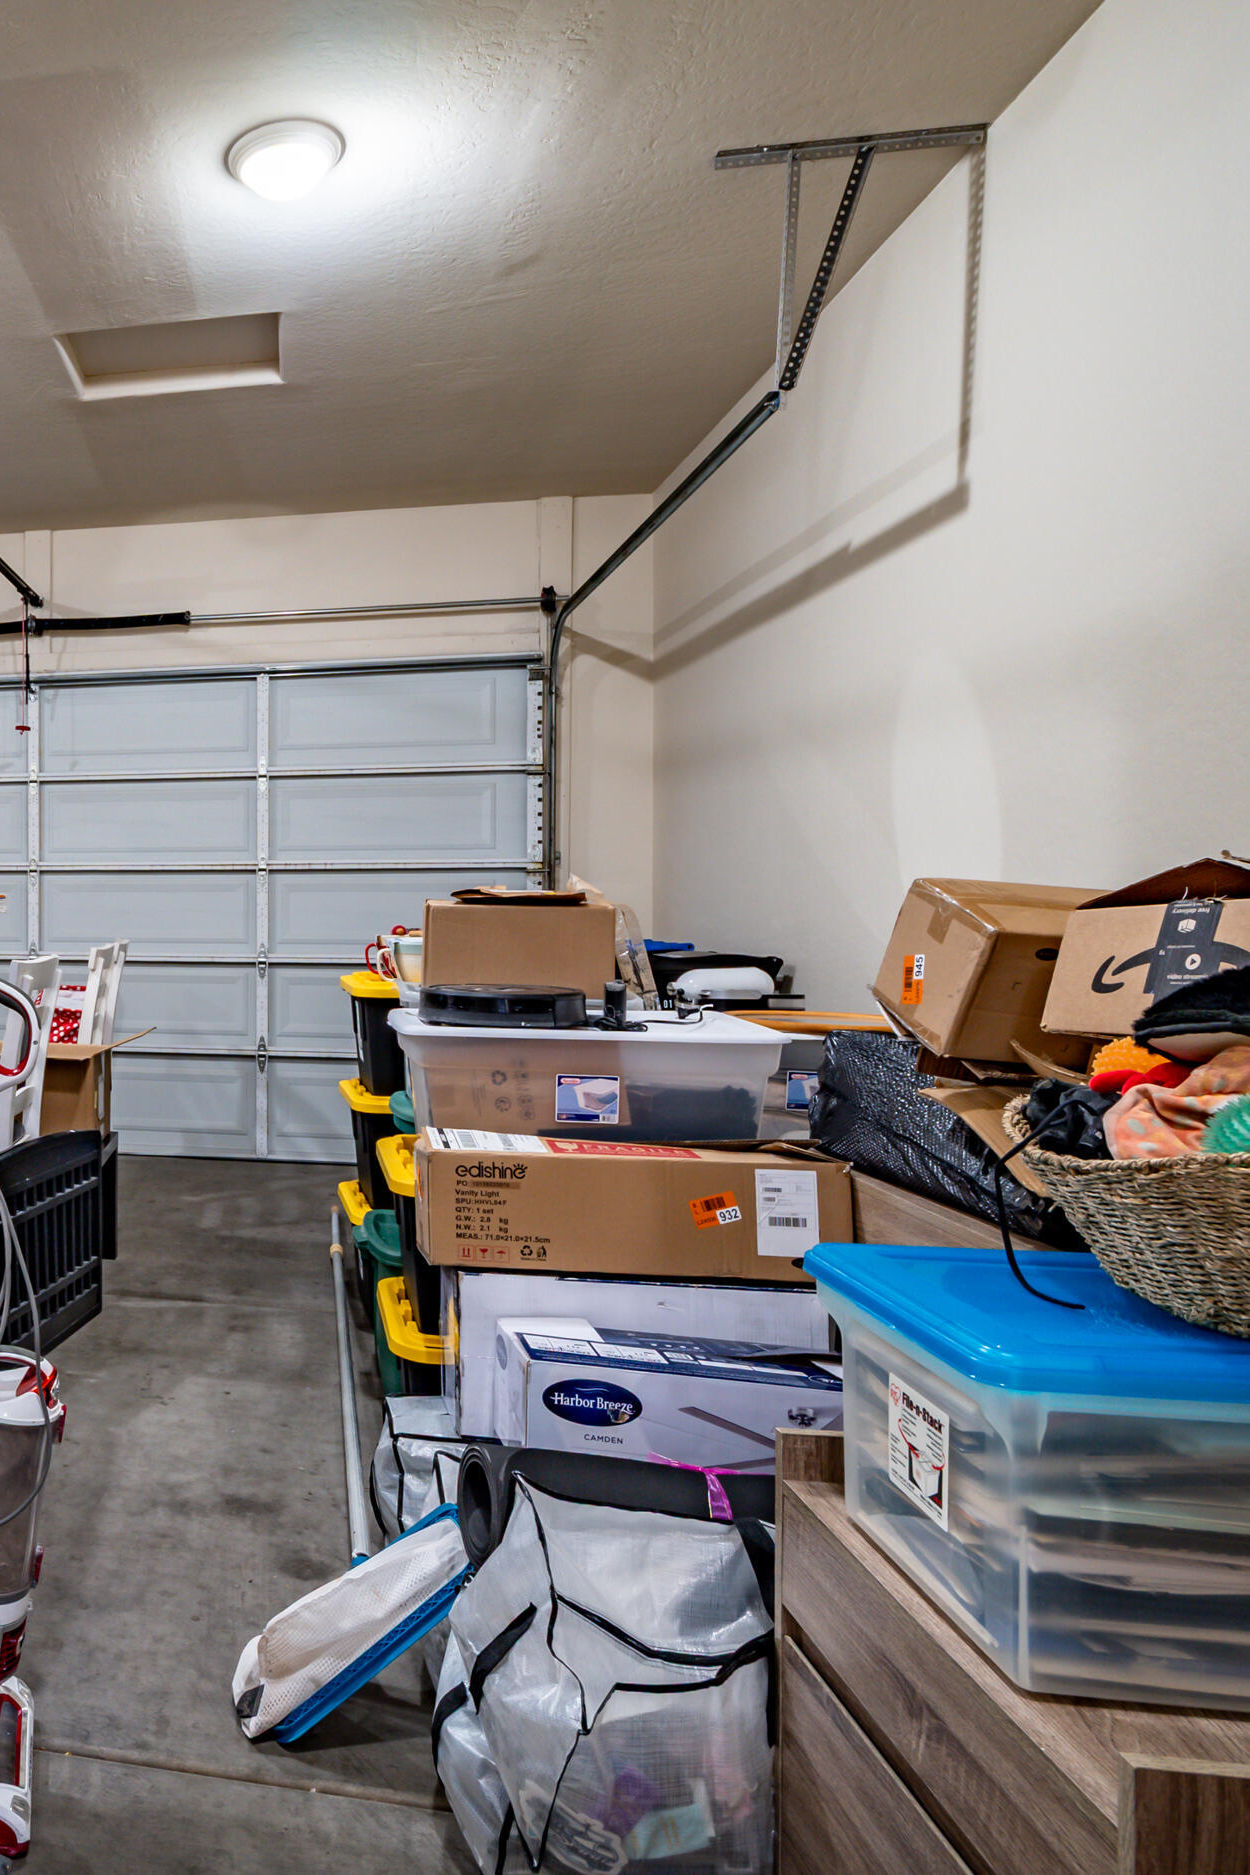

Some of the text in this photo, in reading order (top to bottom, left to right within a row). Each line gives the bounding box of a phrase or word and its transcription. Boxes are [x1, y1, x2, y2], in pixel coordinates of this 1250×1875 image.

[914, 957, 924, 978] 945
[582, 1143, 688, 1154] FRAGILE
[455, 1161, 528, 1179] edishine
[455, 1189, 500, 1198] Vanity Light
[719, 1208, 740, 1222] 932
[499, 1226, 508, 1234] kg
[549, 1391, 635, 1415] Harbor Breeze
[583, 1433, 624, 1445] CAMDEN
